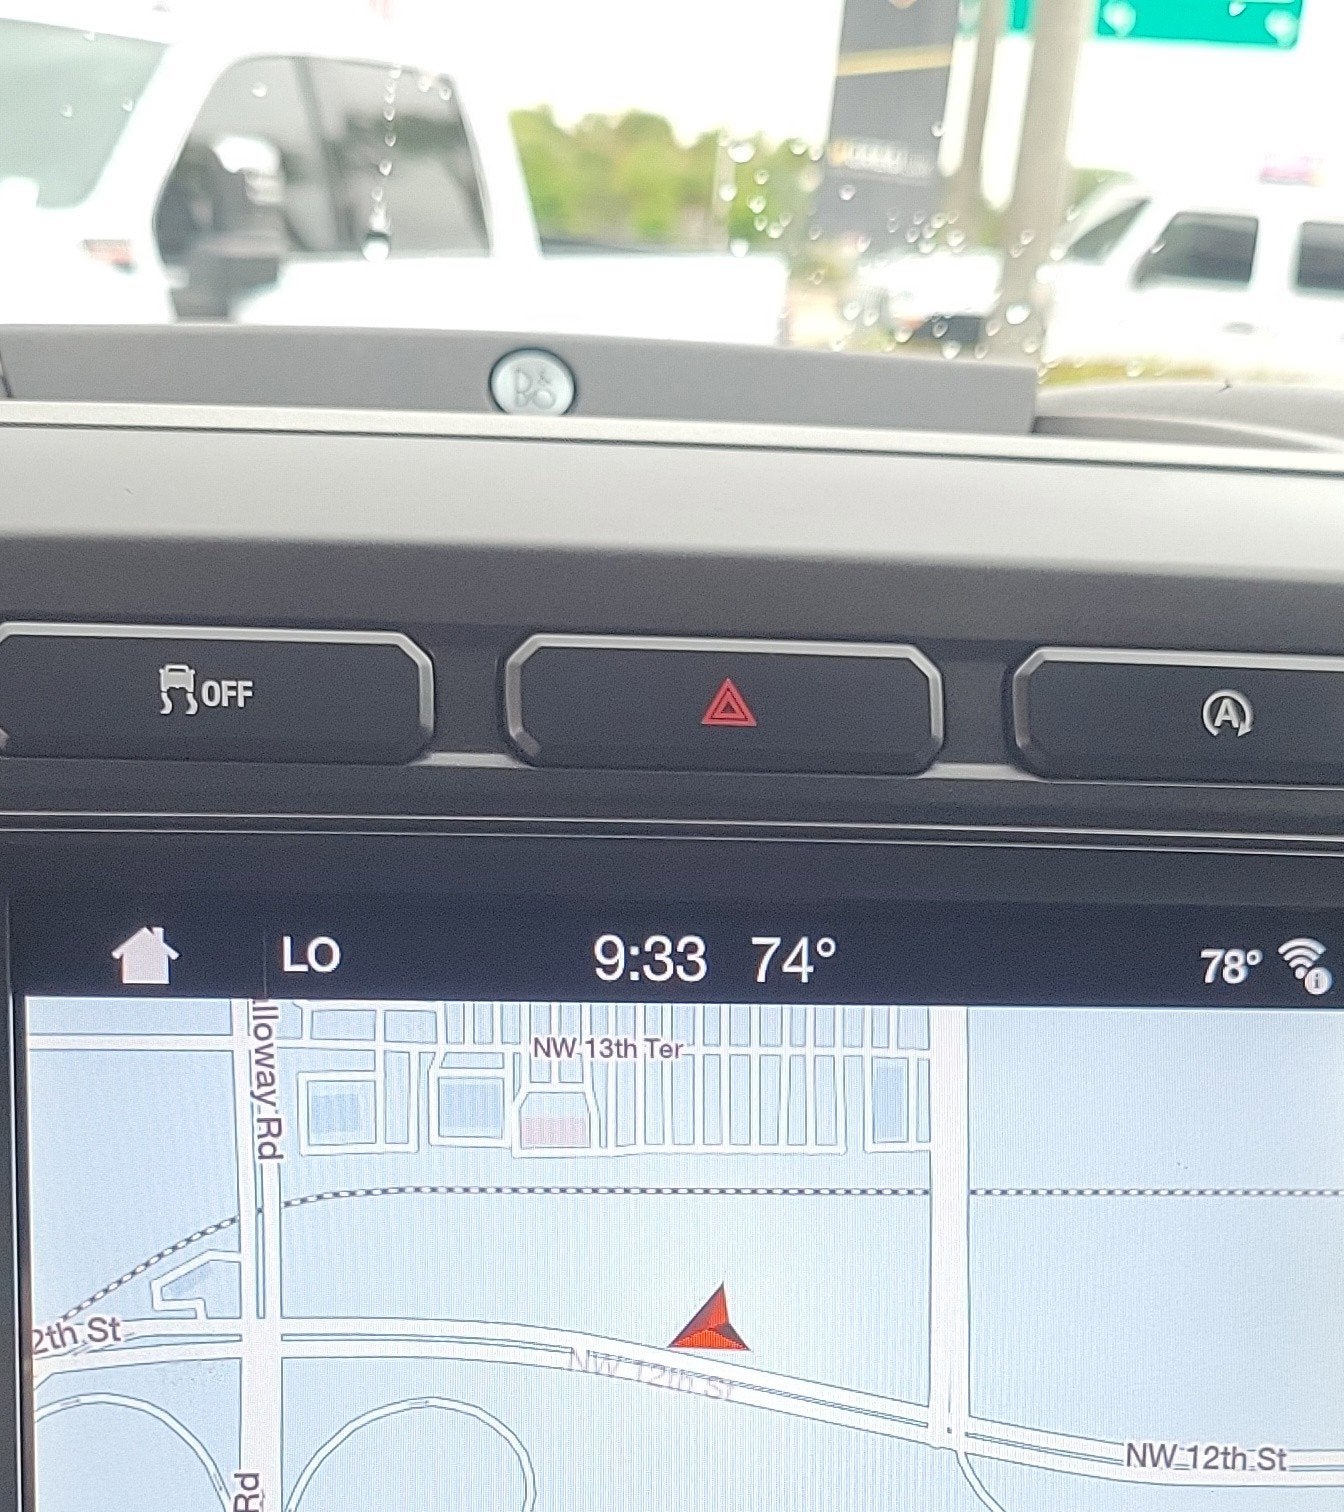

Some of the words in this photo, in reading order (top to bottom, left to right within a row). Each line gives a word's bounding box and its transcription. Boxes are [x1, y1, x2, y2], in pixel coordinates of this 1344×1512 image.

[201, 681, 253, 707] OFF
[282, 936, 341, 972] LO
[594, 934, 708, 982] 9:33
[751, 936, 836, 983] 74°
[1200, 948, 1263, 984] 78°
[534, 1037, 577, 1058] NW
[585, 1037, 637, 1059] 13th
[644, 1038, 684, 1059] Ter
[256, 1117, 284, 1160] Rd
[87, 1316, 122, 1343] St
[1127, 1443, 1177, 1468] NW
[1187, 1445, 1247, 1471] 12th
[1257, 1447, 1287, 1471] St
